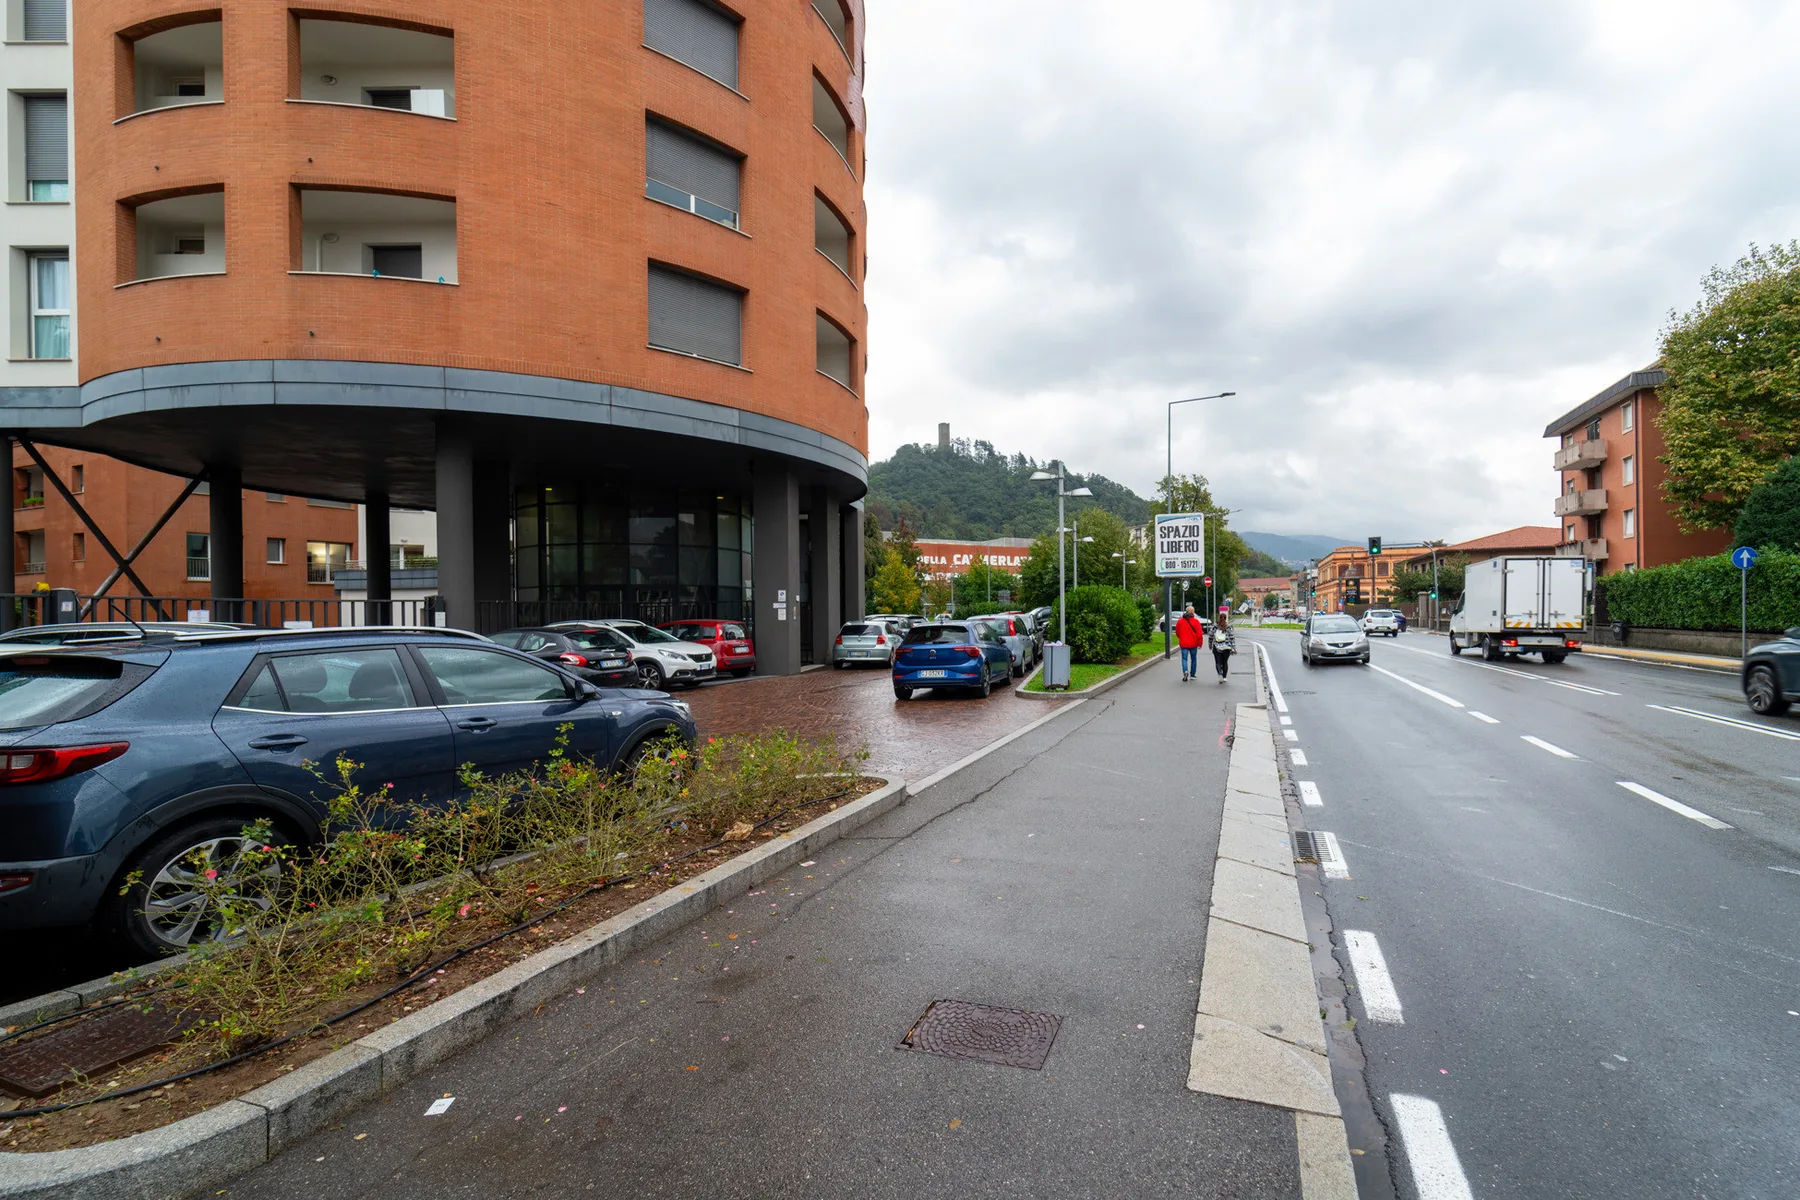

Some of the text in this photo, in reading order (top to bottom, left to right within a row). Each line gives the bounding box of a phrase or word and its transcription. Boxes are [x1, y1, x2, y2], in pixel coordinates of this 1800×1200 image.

[1160, 525, 1199, 538] SPAZIO
[1161, 540, 1198, 553] LIBERO
[953, 554, 973, 565] CA'
[1166, 561, 1176, 569] 800
[1180, 560, 1198, 568] 151721
